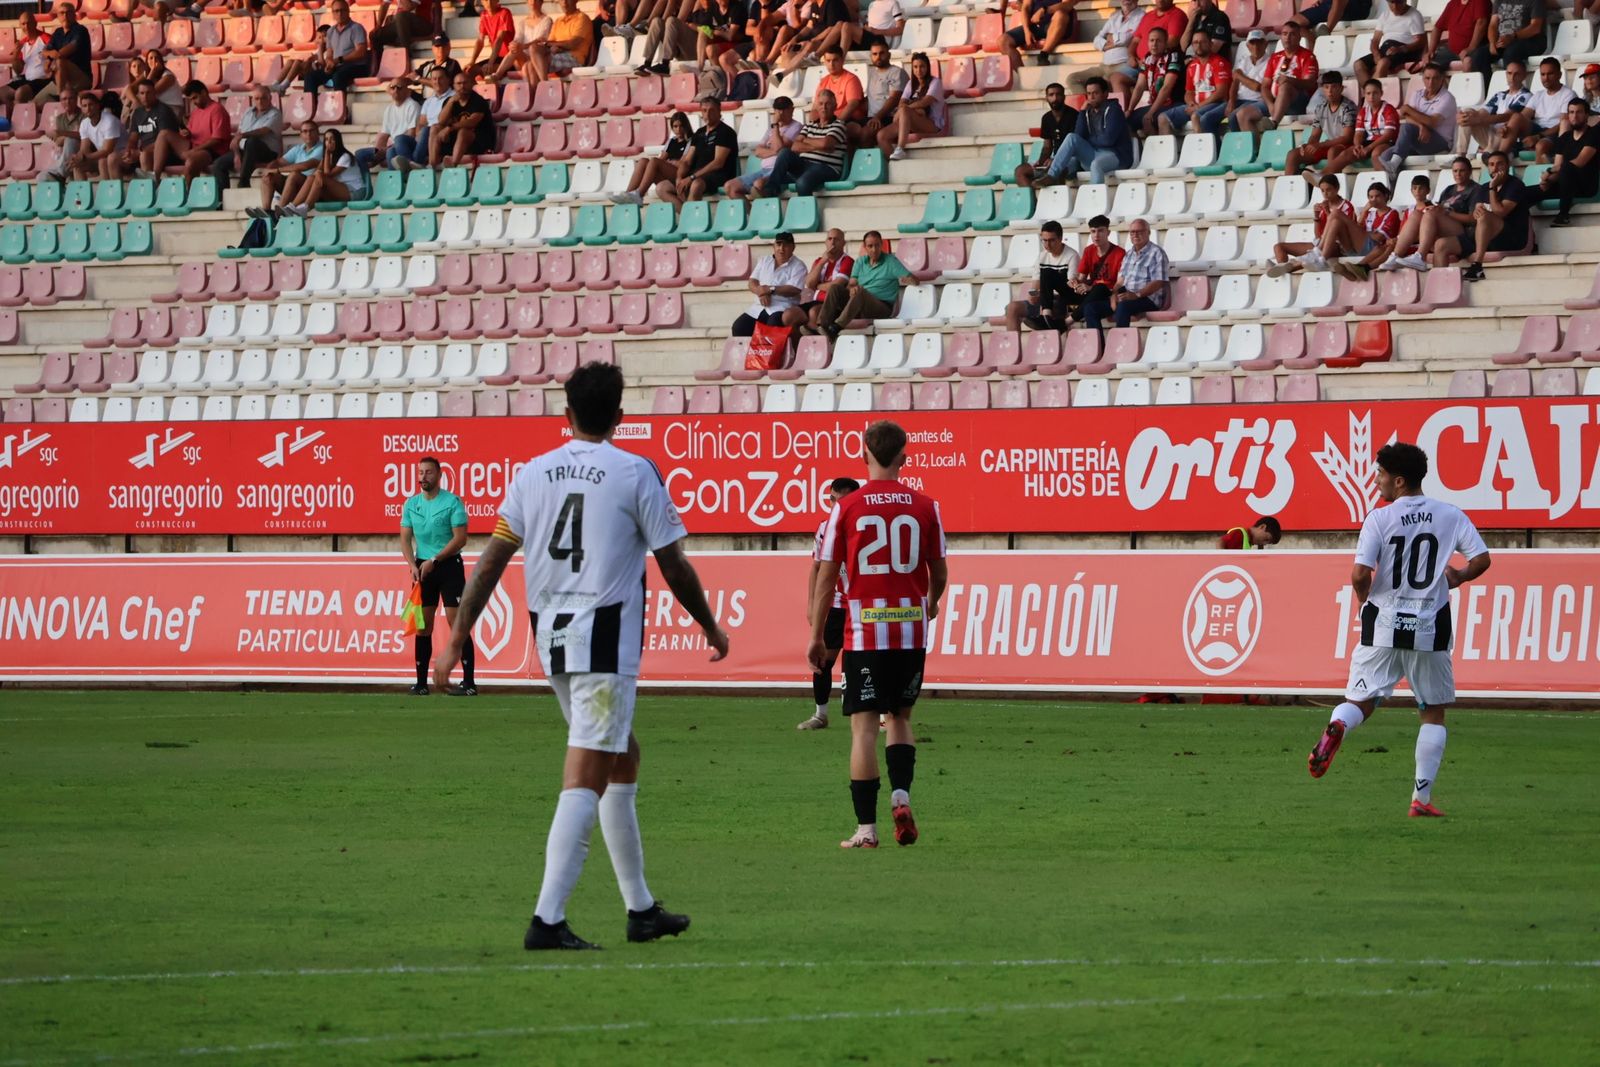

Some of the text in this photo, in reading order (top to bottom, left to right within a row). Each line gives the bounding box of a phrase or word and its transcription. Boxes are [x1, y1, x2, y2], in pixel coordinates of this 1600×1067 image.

[383, 434, 459, 452] DESGUACES
[664, 421, 868, 460] Clínica Denta
[940, 427, 953, 443] de
[40, 447, 58, 466] sgc
[183, 446, 202, 465] sgc
[313, 444, 332, 464] sgc
[931, 451, 956, 467] Local
[958, 452, 967, 467] A
[980, 441, 1121, 473] CARPINTERÍA
[1416, 404, 1600, 520] CAJ
[545, 464, 606, 484] TRILLES
[1125, 417, 1297, 516] Ortiz
[108, 477, 223, 517] sangregorio
[236, 476, 355, 516] sangregorio
[1024, 473, 1120, 497] HIJOS DE
[0, 478, 79, 517] gregorio
[465, 501, 495, 516] ÍCULOS
[863, 492, 912, 507] TRESACO
[0, 521, 53, 529] ONSTRUCCION
[135, 520, 196, 529] CONSTRUCCION
[264, 520, 327, 529] CONSTRUCCION
[1401, 512, 1433, 527] MENA
[548, 492, 585, 573] 4
[856, 514, 921, 575] 20
[1389, 532, 1439, 590] 10
[245, 589, 411, 617] TIENDA ONL
[120, 595, 206, 652] Chef
[1448, 584, 1600, 662] ERACI
[237, 628, 406, 654] PARTICULARES
[642, 634, 715, 650] EARNI
